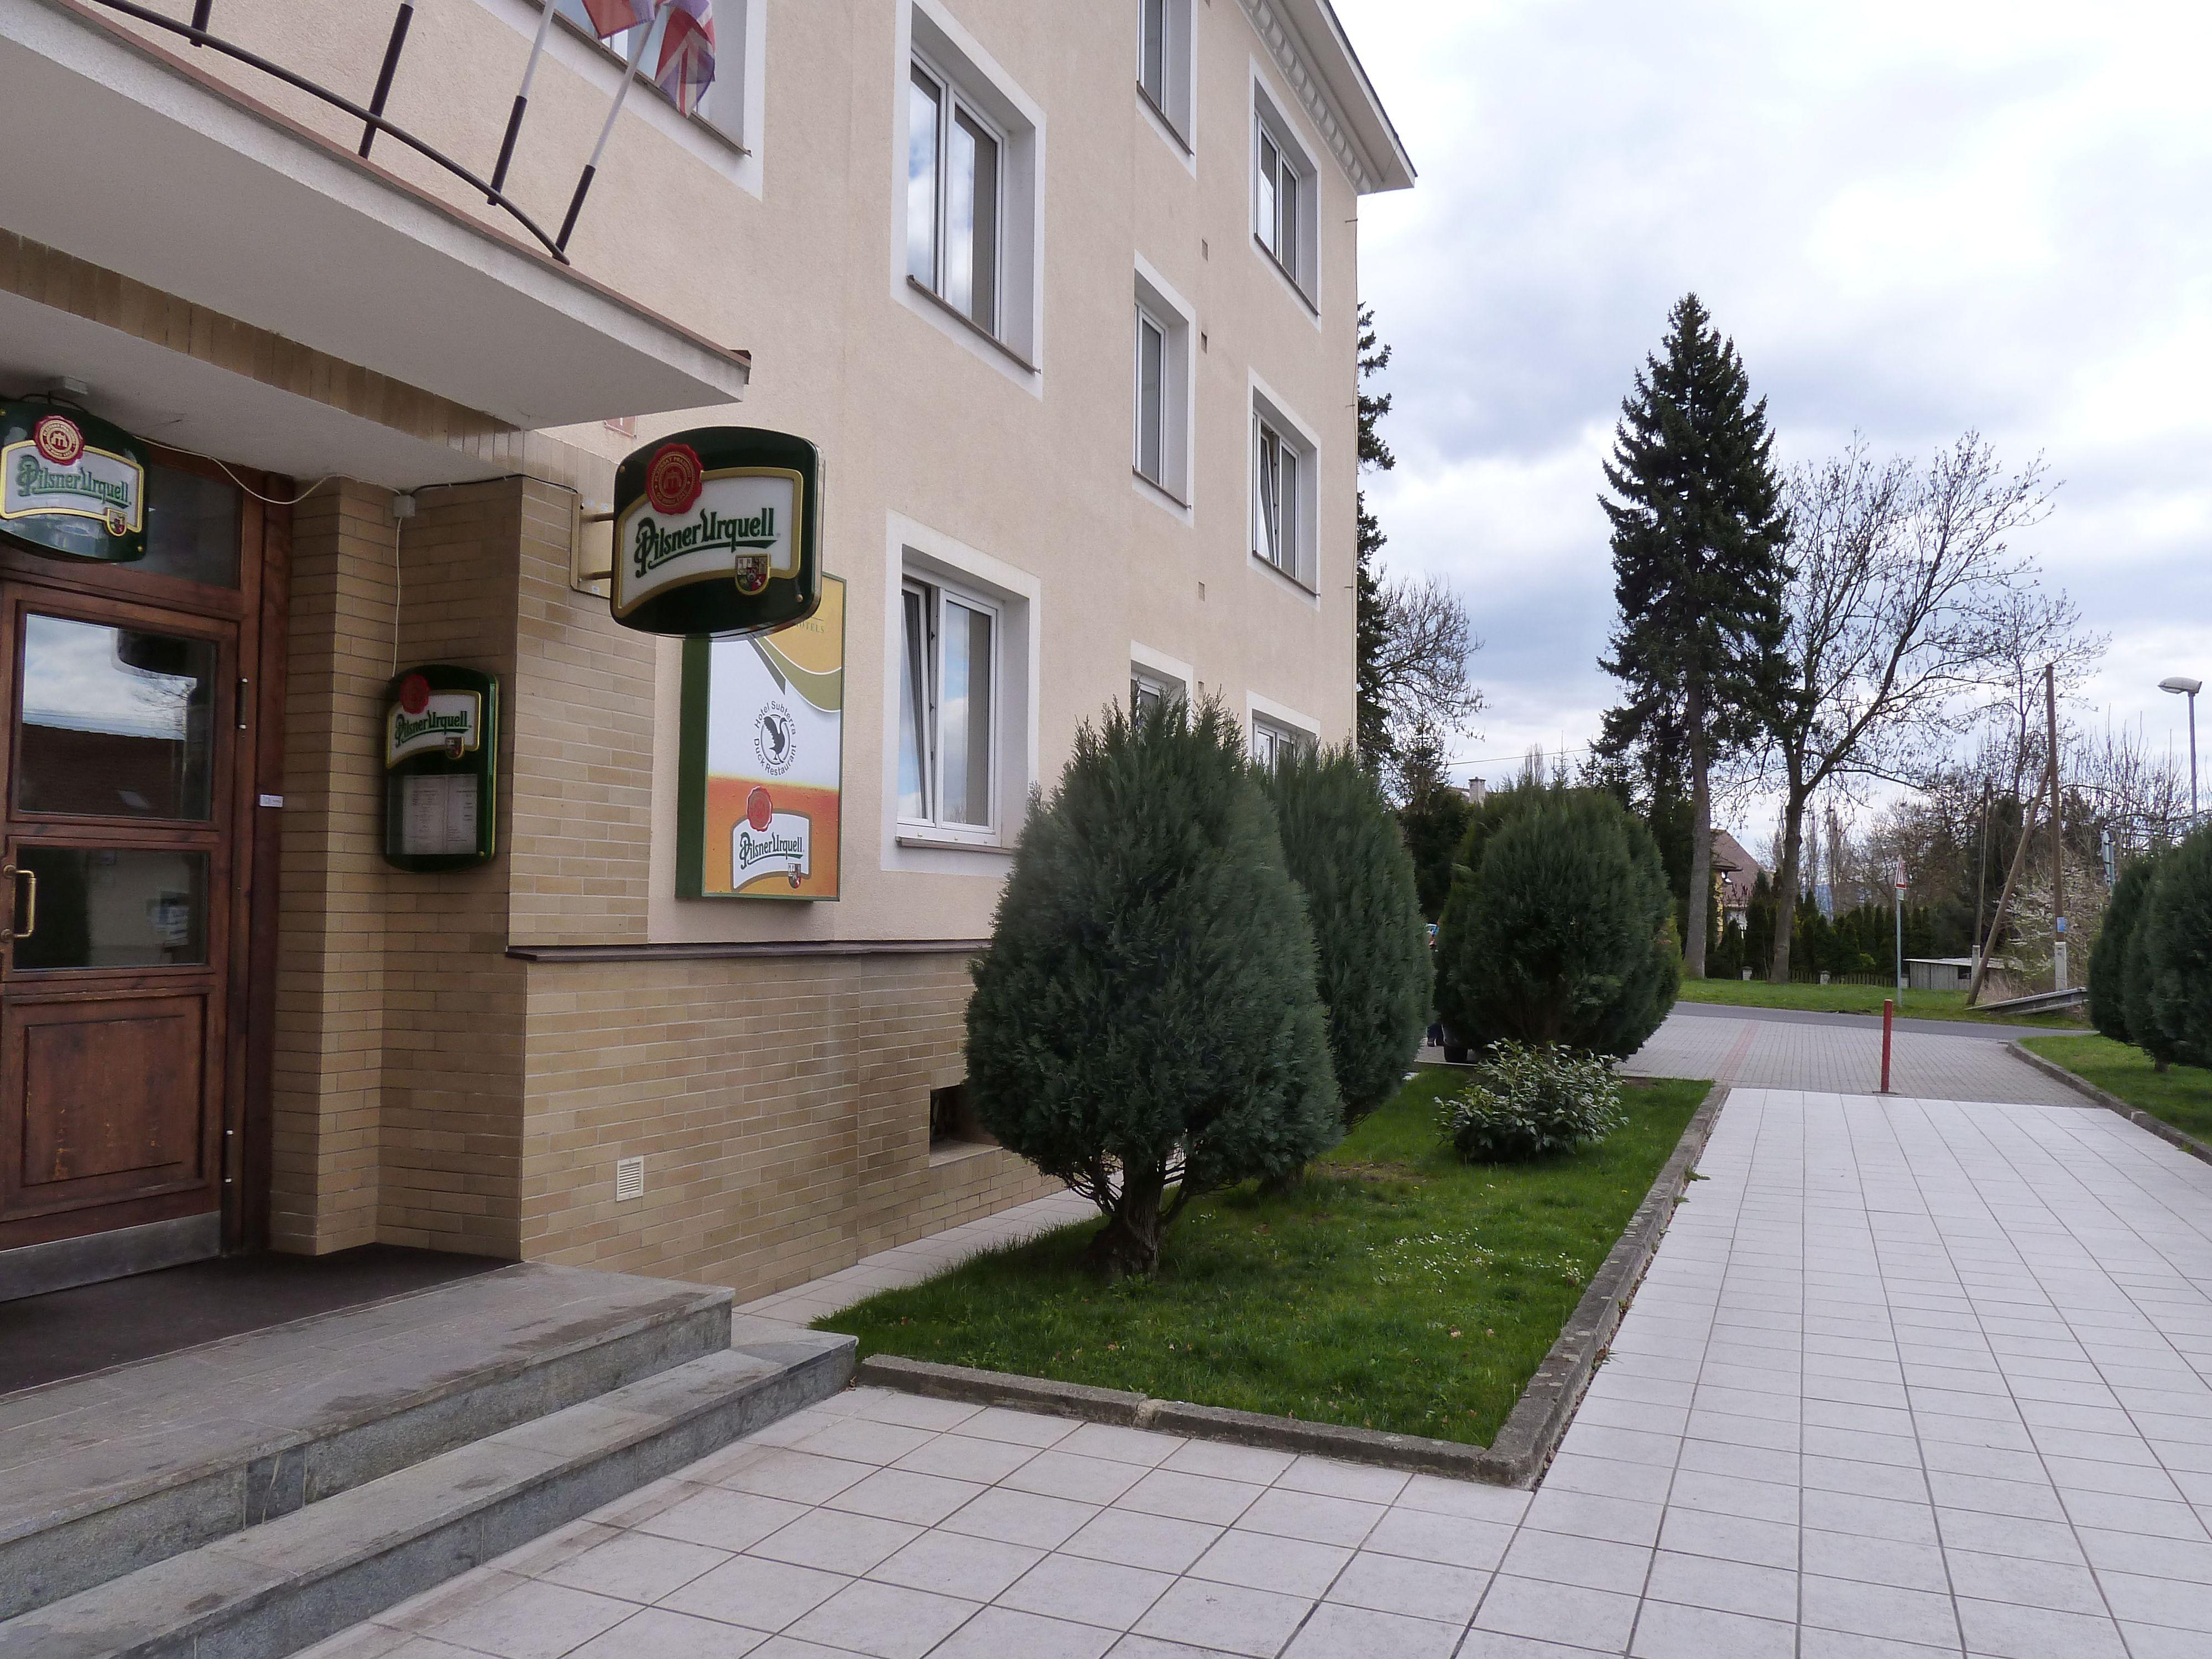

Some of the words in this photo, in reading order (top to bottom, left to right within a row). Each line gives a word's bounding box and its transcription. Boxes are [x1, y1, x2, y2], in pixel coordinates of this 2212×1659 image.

[15, 455, 81, 497] Pilsner
[80, 467, 128, 504] Urquell
[634, 517, 701, 578] Pilsner
[700, 508, 774, 553] Urquell
[796, 621, 825, 634] OTELS
[395, 714, 428, 747] Pilsner
[427, 710, 467, 734] Urquell
[754, 702, 770, 729] Hotel
[771, 701, 796, 735] Subterra
[754, 738, 765, 766] Duck
[765, 744, 796, 776] Restaurant
[739, 832, 773, 870] Pilsner
[771, 832, 802, 860] Urquell
